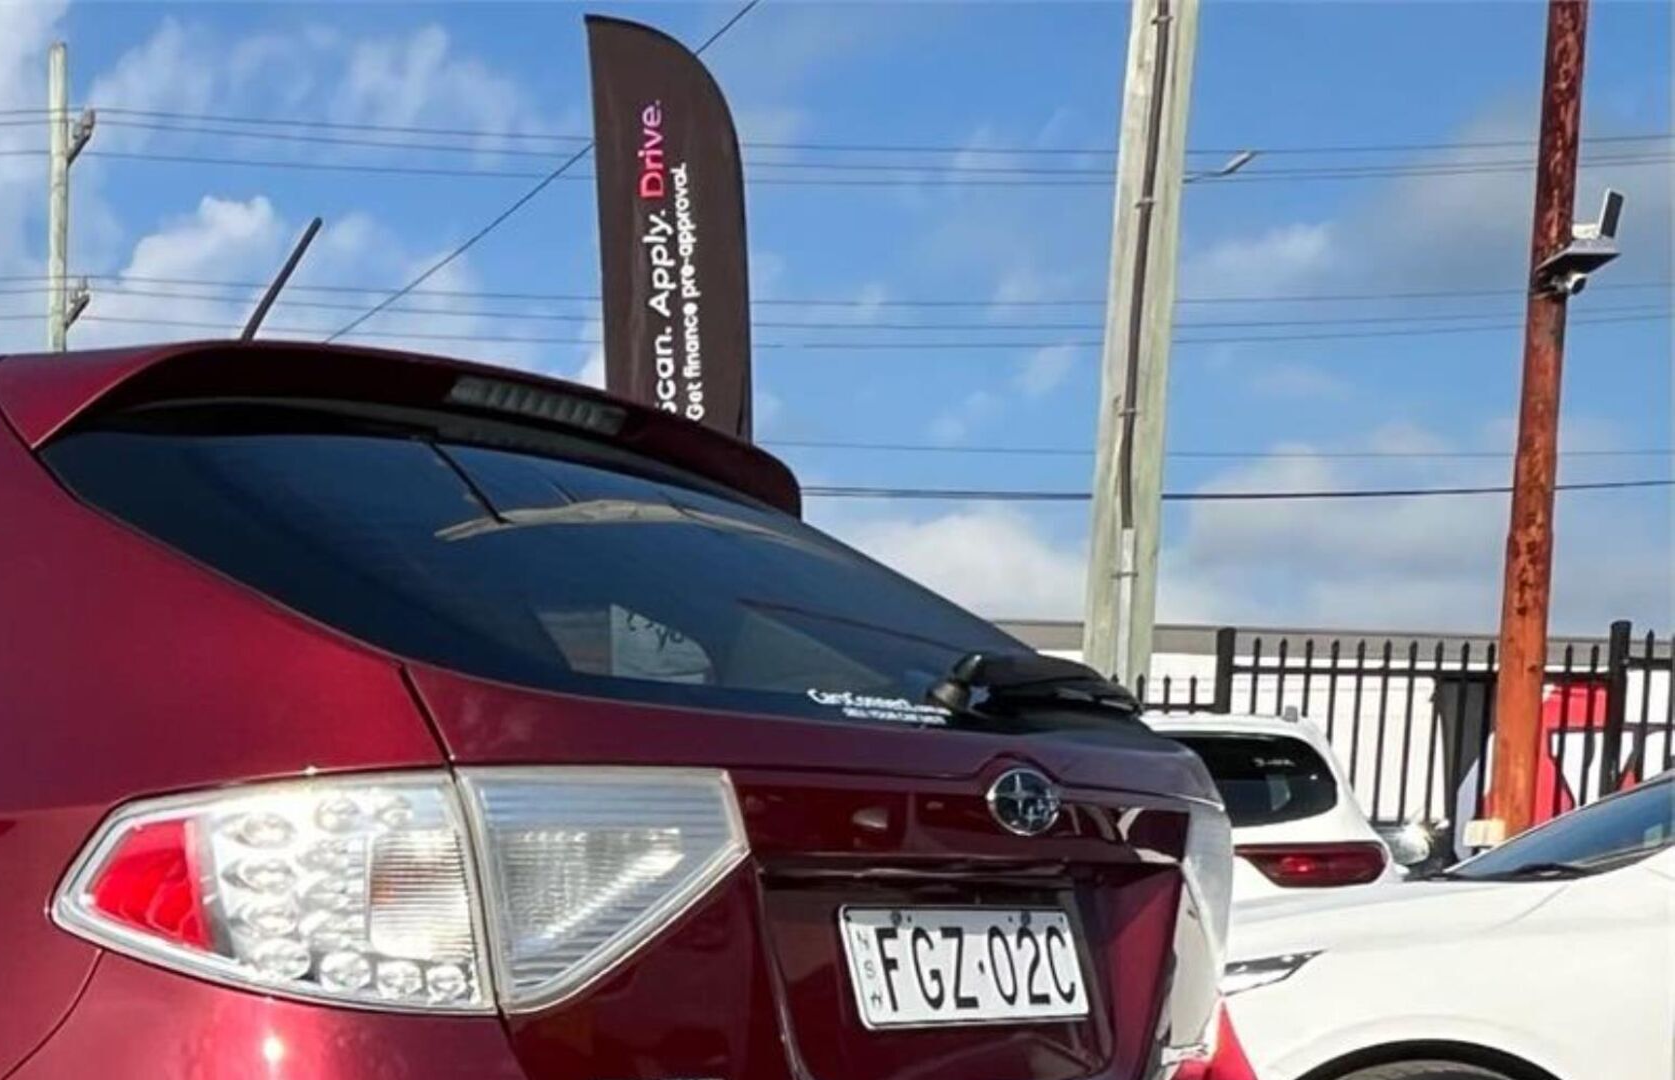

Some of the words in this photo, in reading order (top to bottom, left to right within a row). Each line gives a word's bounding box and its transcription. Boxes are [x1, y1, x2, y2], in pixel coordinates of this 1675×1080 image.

[637, 100, 665, 198] Drive.
[643, 209, 677, 317] Apply.
[681, 302, 701, 379] finance
[685, 380, 705, 422] Get
